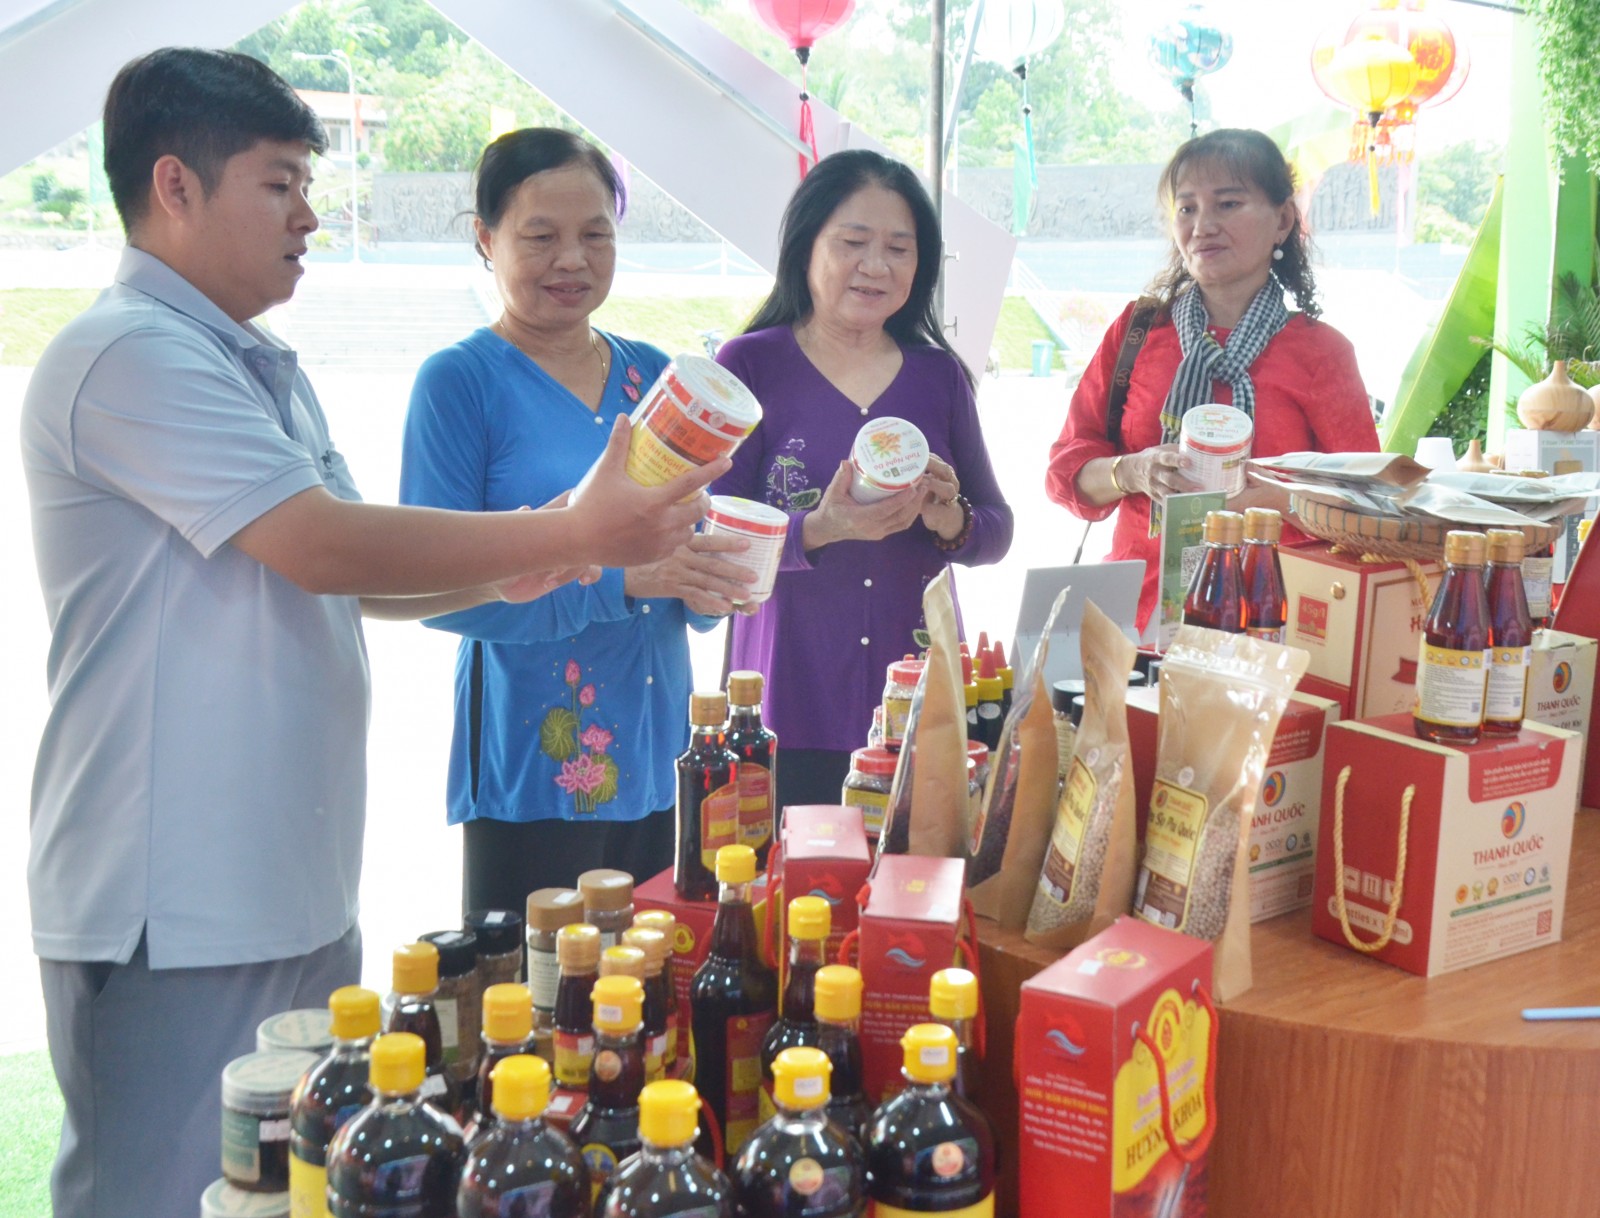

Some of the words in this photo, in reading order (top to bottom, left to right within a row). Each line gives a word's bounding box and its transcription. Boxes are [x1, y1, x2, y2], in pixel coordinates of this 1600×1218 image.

[1472, 845, 1510, 865] THANH
[1512, 834, 1544, 855] QUỐC
[1126, 1124, 1161, 1169] HUỲN
